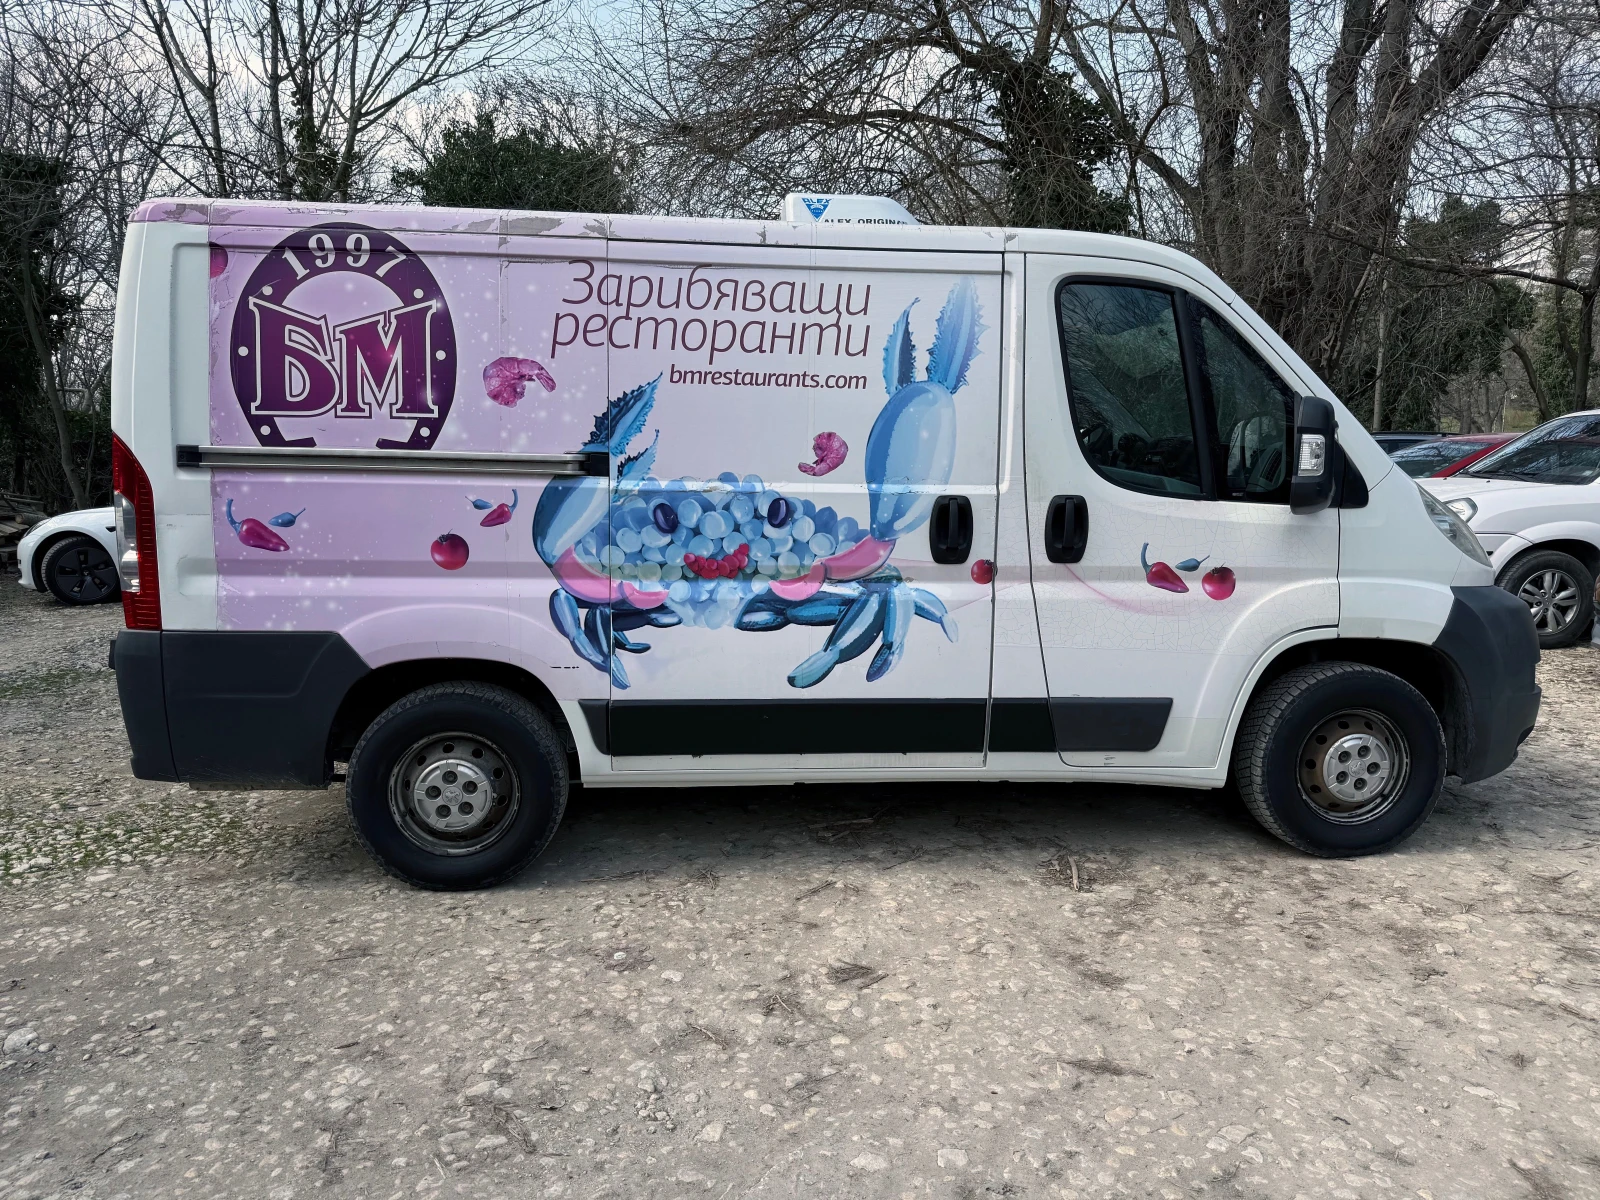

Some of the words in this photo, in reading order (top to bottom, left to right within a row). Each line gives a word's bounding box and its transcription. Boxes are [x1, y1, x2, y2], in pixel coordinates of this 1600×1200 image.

[282, 233, 407, 280] 1997
[561, 259, 871, 325] Зарибяващи
[248, 296, 439, 418] БМ
[550, 311, 871, 365] ресторанти
[669, 364, 867, 389] bmrestaurants.com
